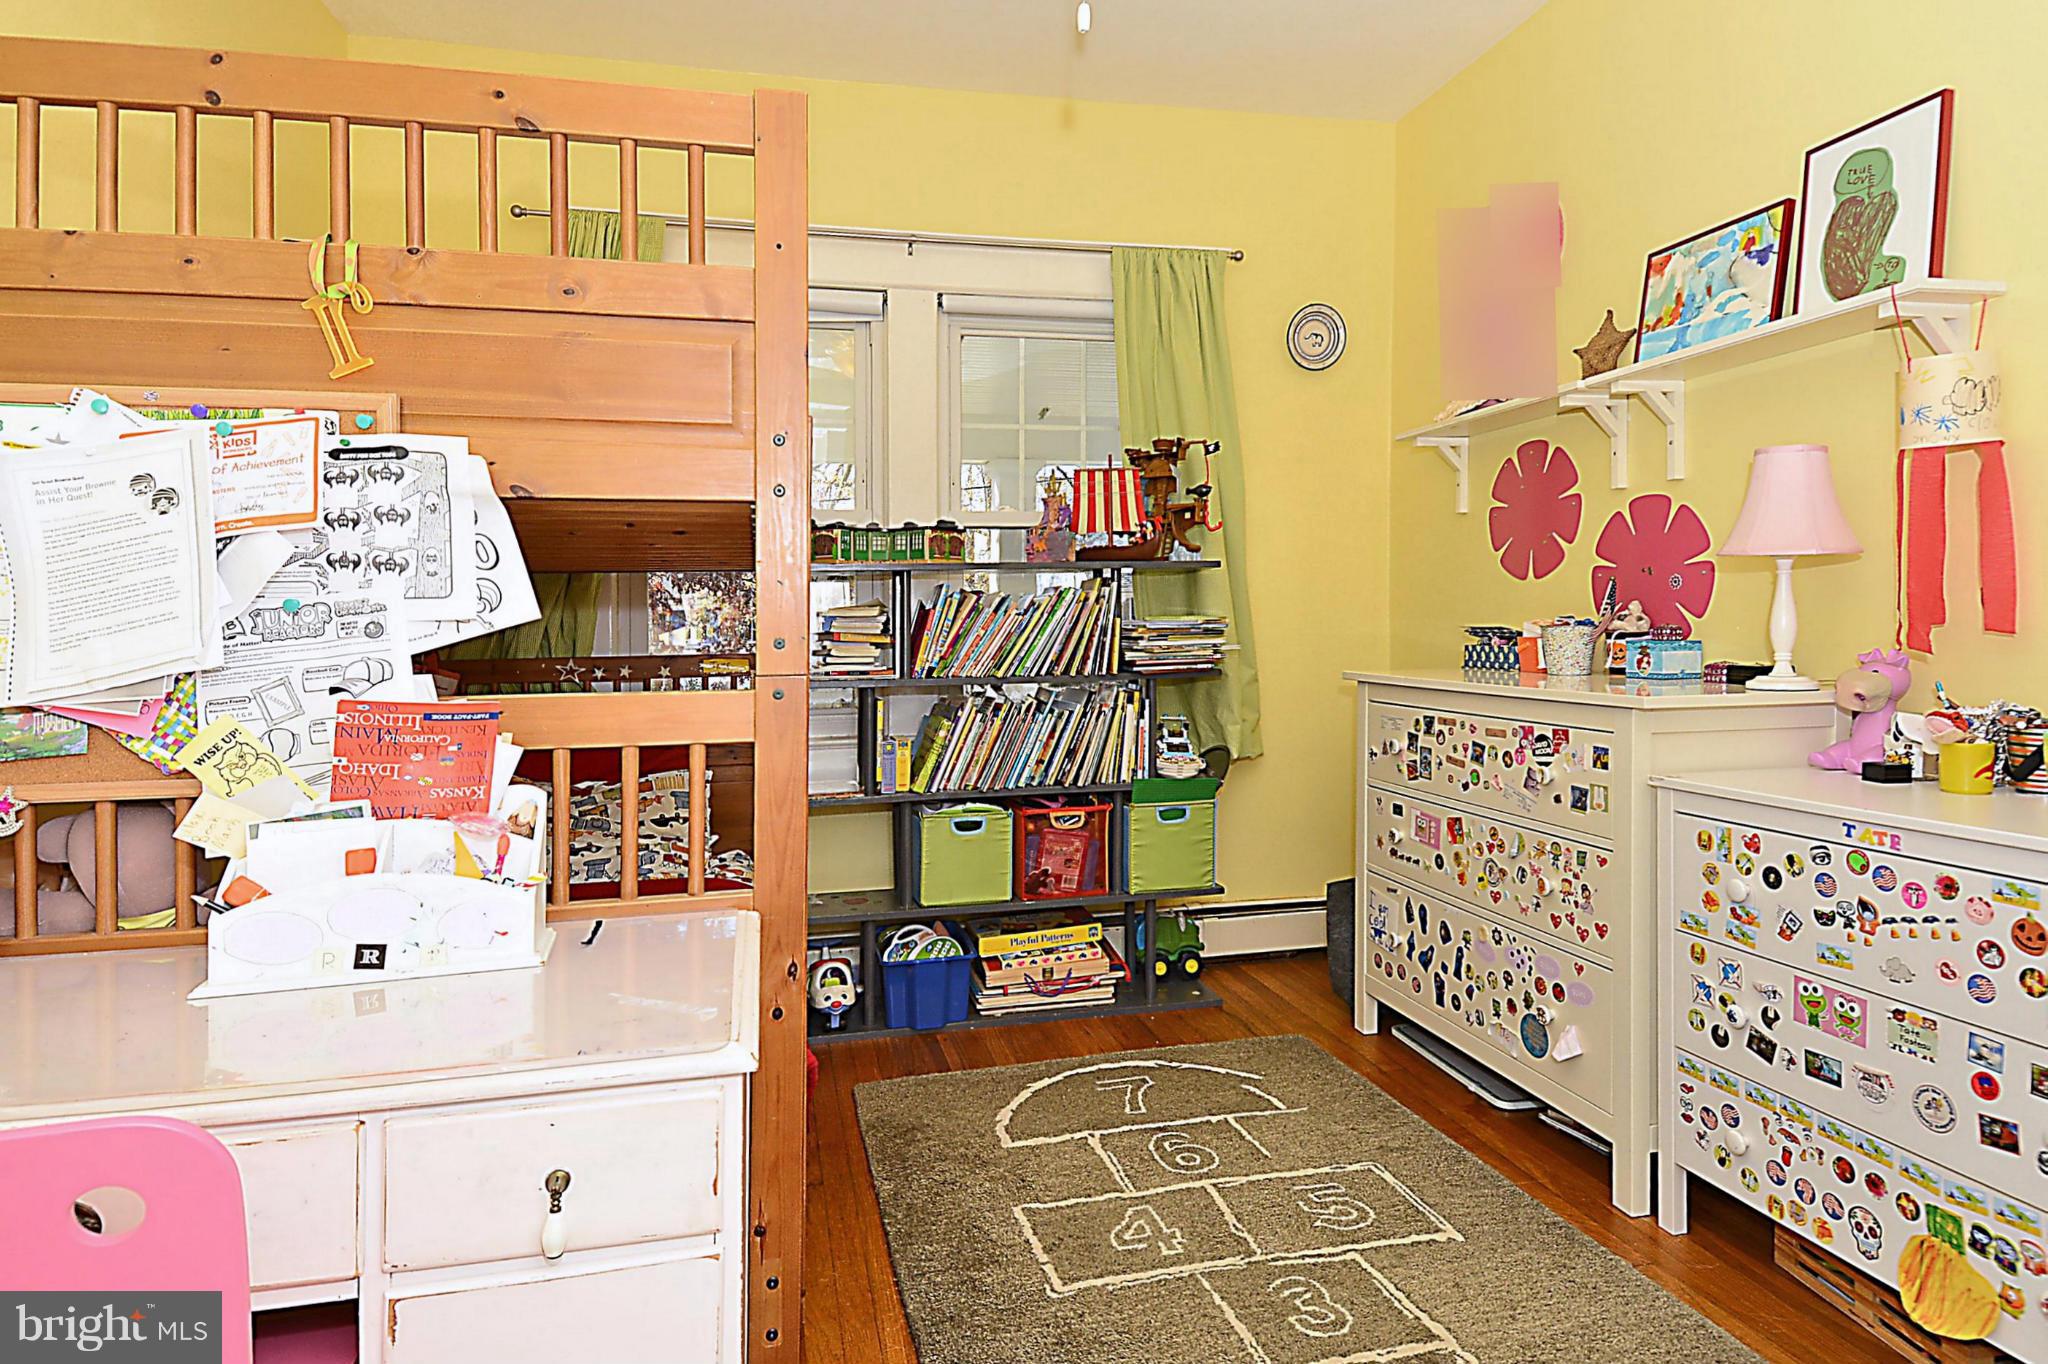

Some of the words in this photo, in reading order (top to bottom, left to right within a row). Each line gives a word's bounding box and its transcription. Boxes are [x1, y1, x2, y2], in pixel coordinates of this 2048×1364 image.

[1847, 164, 1874, 176] TRUE
[1847, 174, 1876, 186] LOVE
[223, 437, 251, 449] KIDS
[211, 463, 228, 475] of
[231, 453, 304, 472] Achievement
[34, 486, 62, 496] Assist
[64, 485, 82, 494] Your
[85, 480, 117, 490] Brownie
[36, 497, 47, 505] in
[48, 495, 64, 504] Her
[67, 491, 93, 502] Quest!
[250, 603, 331, 634] JUNIOR
[344, 712, 422, 731] ILLINOIS
[193, 742, 224, 767] WISE
[221, 728, 242, 745] UP!
[339, 763, 402, 780] IDAHO
[331, 786, 372, 798] COLO
[430, 786, 487, 799] KANSAS
[1842, 822, 1901, 851] TATE
[1010, 935, 1039, 948] Playful
[1041, 932, 1074, 943] Patterns
[360, 949, 380, 964] R
[1096, 1074, 1154, 1114] 7
[1148, 1131, 1220, 1173] 6
[1293, 1183, 1377, 1231] 5
[1110, 1205, 1185, 1255] 4
[1268, 1275, 1353, 1337] 3
